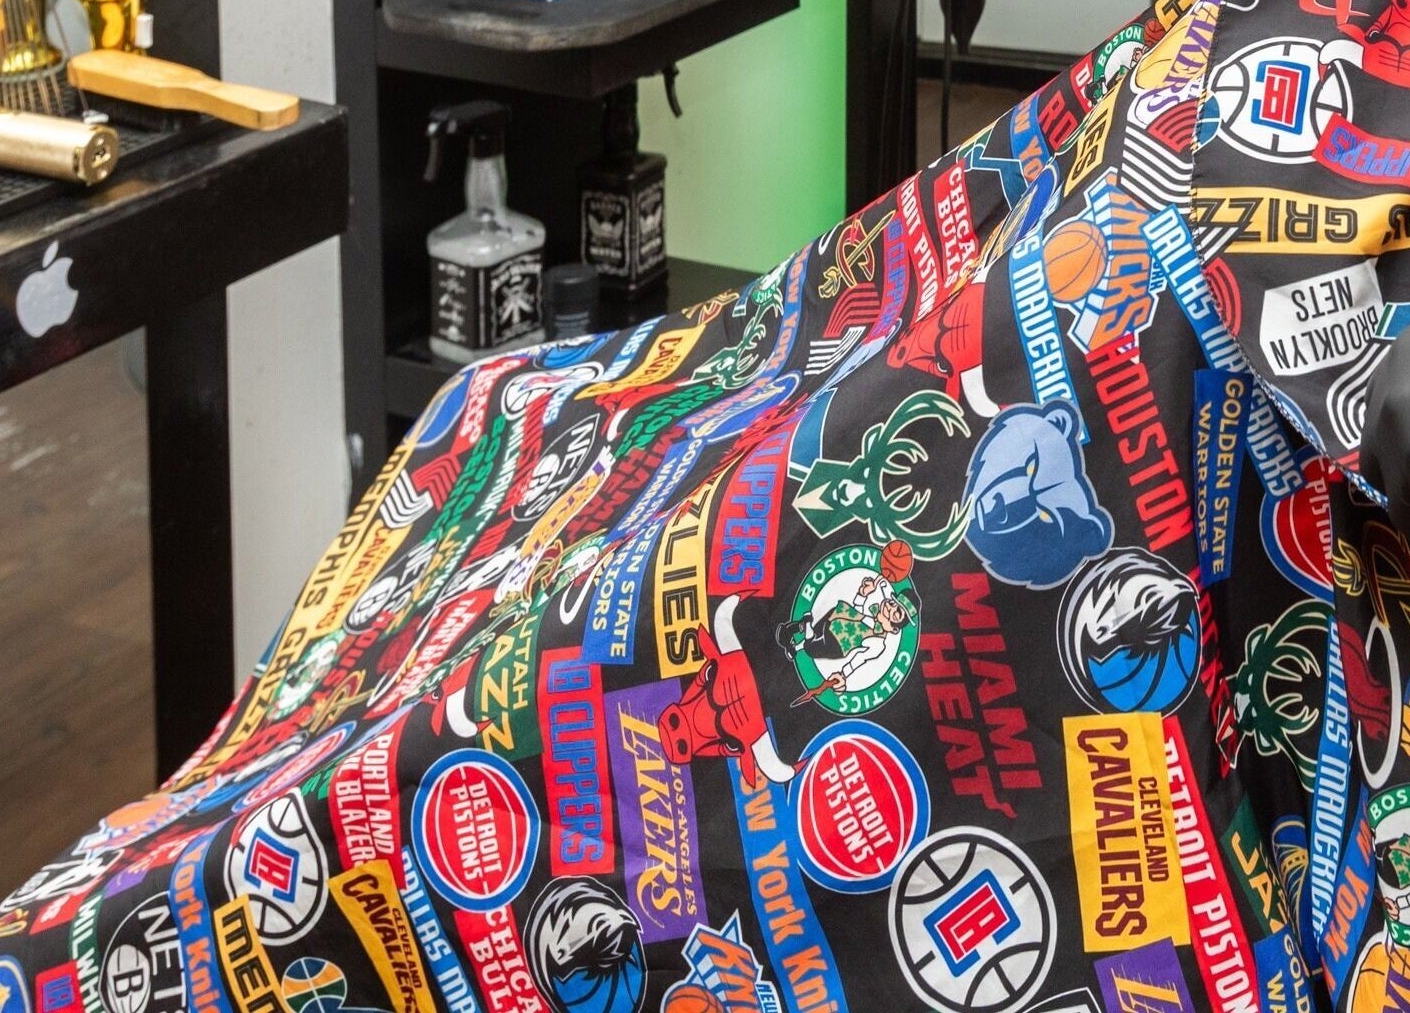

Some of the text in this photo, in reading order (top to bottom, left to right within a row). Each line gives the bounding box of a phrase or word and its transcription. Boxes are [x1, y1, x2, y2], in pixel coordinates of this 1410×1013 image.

[1098, 27, 1145, 68] BOSTON
[1147, 211, 1214, 321] DALLAS
[1290, 275, 1356, 324] NETS
[1085, 335, 1197, 553] HOUSTON
[1196, 400, 1218, 555] WARRIORS
[1210, 377, 1247, 576] GOLDEN STATE
[610, 580, 636, 659] STATE
[801, 547, 878, 603] BOSTON
[511, 616, 539, 710] UTAH
[836, 650, 912, 715] CELTICS
[950, 572, 1043, 790] MIAMI
[920, 632, 1018, 819] HEAT
[362, 731, 395, 856] PORTLAND
[449, 784, 484, 883] PISTONS
[469, 779, 504, 876] DETROIT
[549, 700, 604, 866] CLIPPERS
[618, 699, 684, 928] LAKERS
[820, 769, 875, 865] PISTONS
[839, 752, 895, 853] DETROIT
[1076, 727, 1149, 938] CAVALIERS
[1137, 775, 1171, 884] CLEVELAND
[1164, 736, 1217, 888] DETROIT
[676, 805, 699, 918] ANGELES
[391, 907, 423, 989] CLEVELAND
